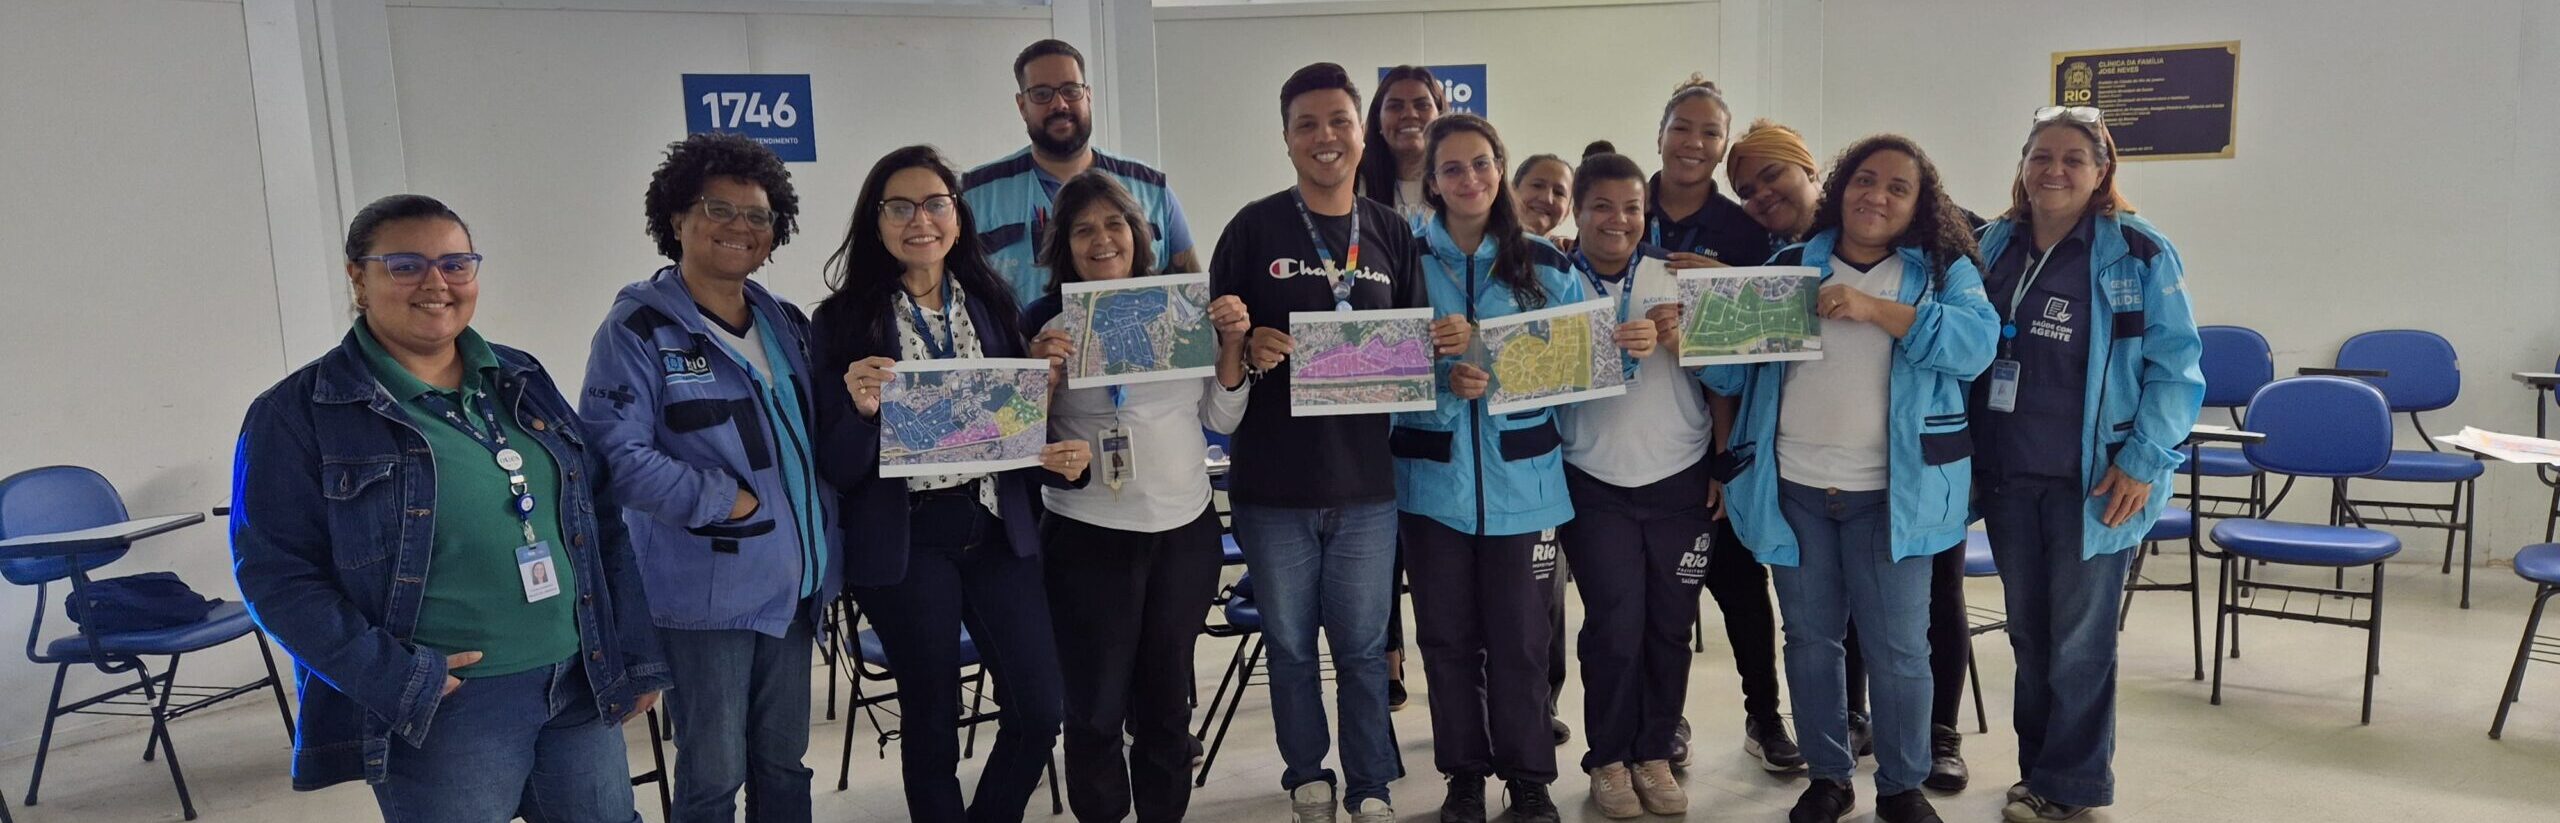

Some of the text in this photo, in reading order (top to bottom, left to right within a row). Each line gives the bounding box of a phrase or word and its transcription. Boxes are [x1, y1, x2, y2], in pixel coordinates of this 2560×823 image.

[2064, 89, 2092, 102] RIO
[702, 92, 797, 128] 1746
[2030, 326, 2071, 342] AGENTE
[2032, 320, 2073, 334] SAÚDE COM
[1532, 543, 1556, 562] Rio
[1680, 551, 1708, 568] Rio
